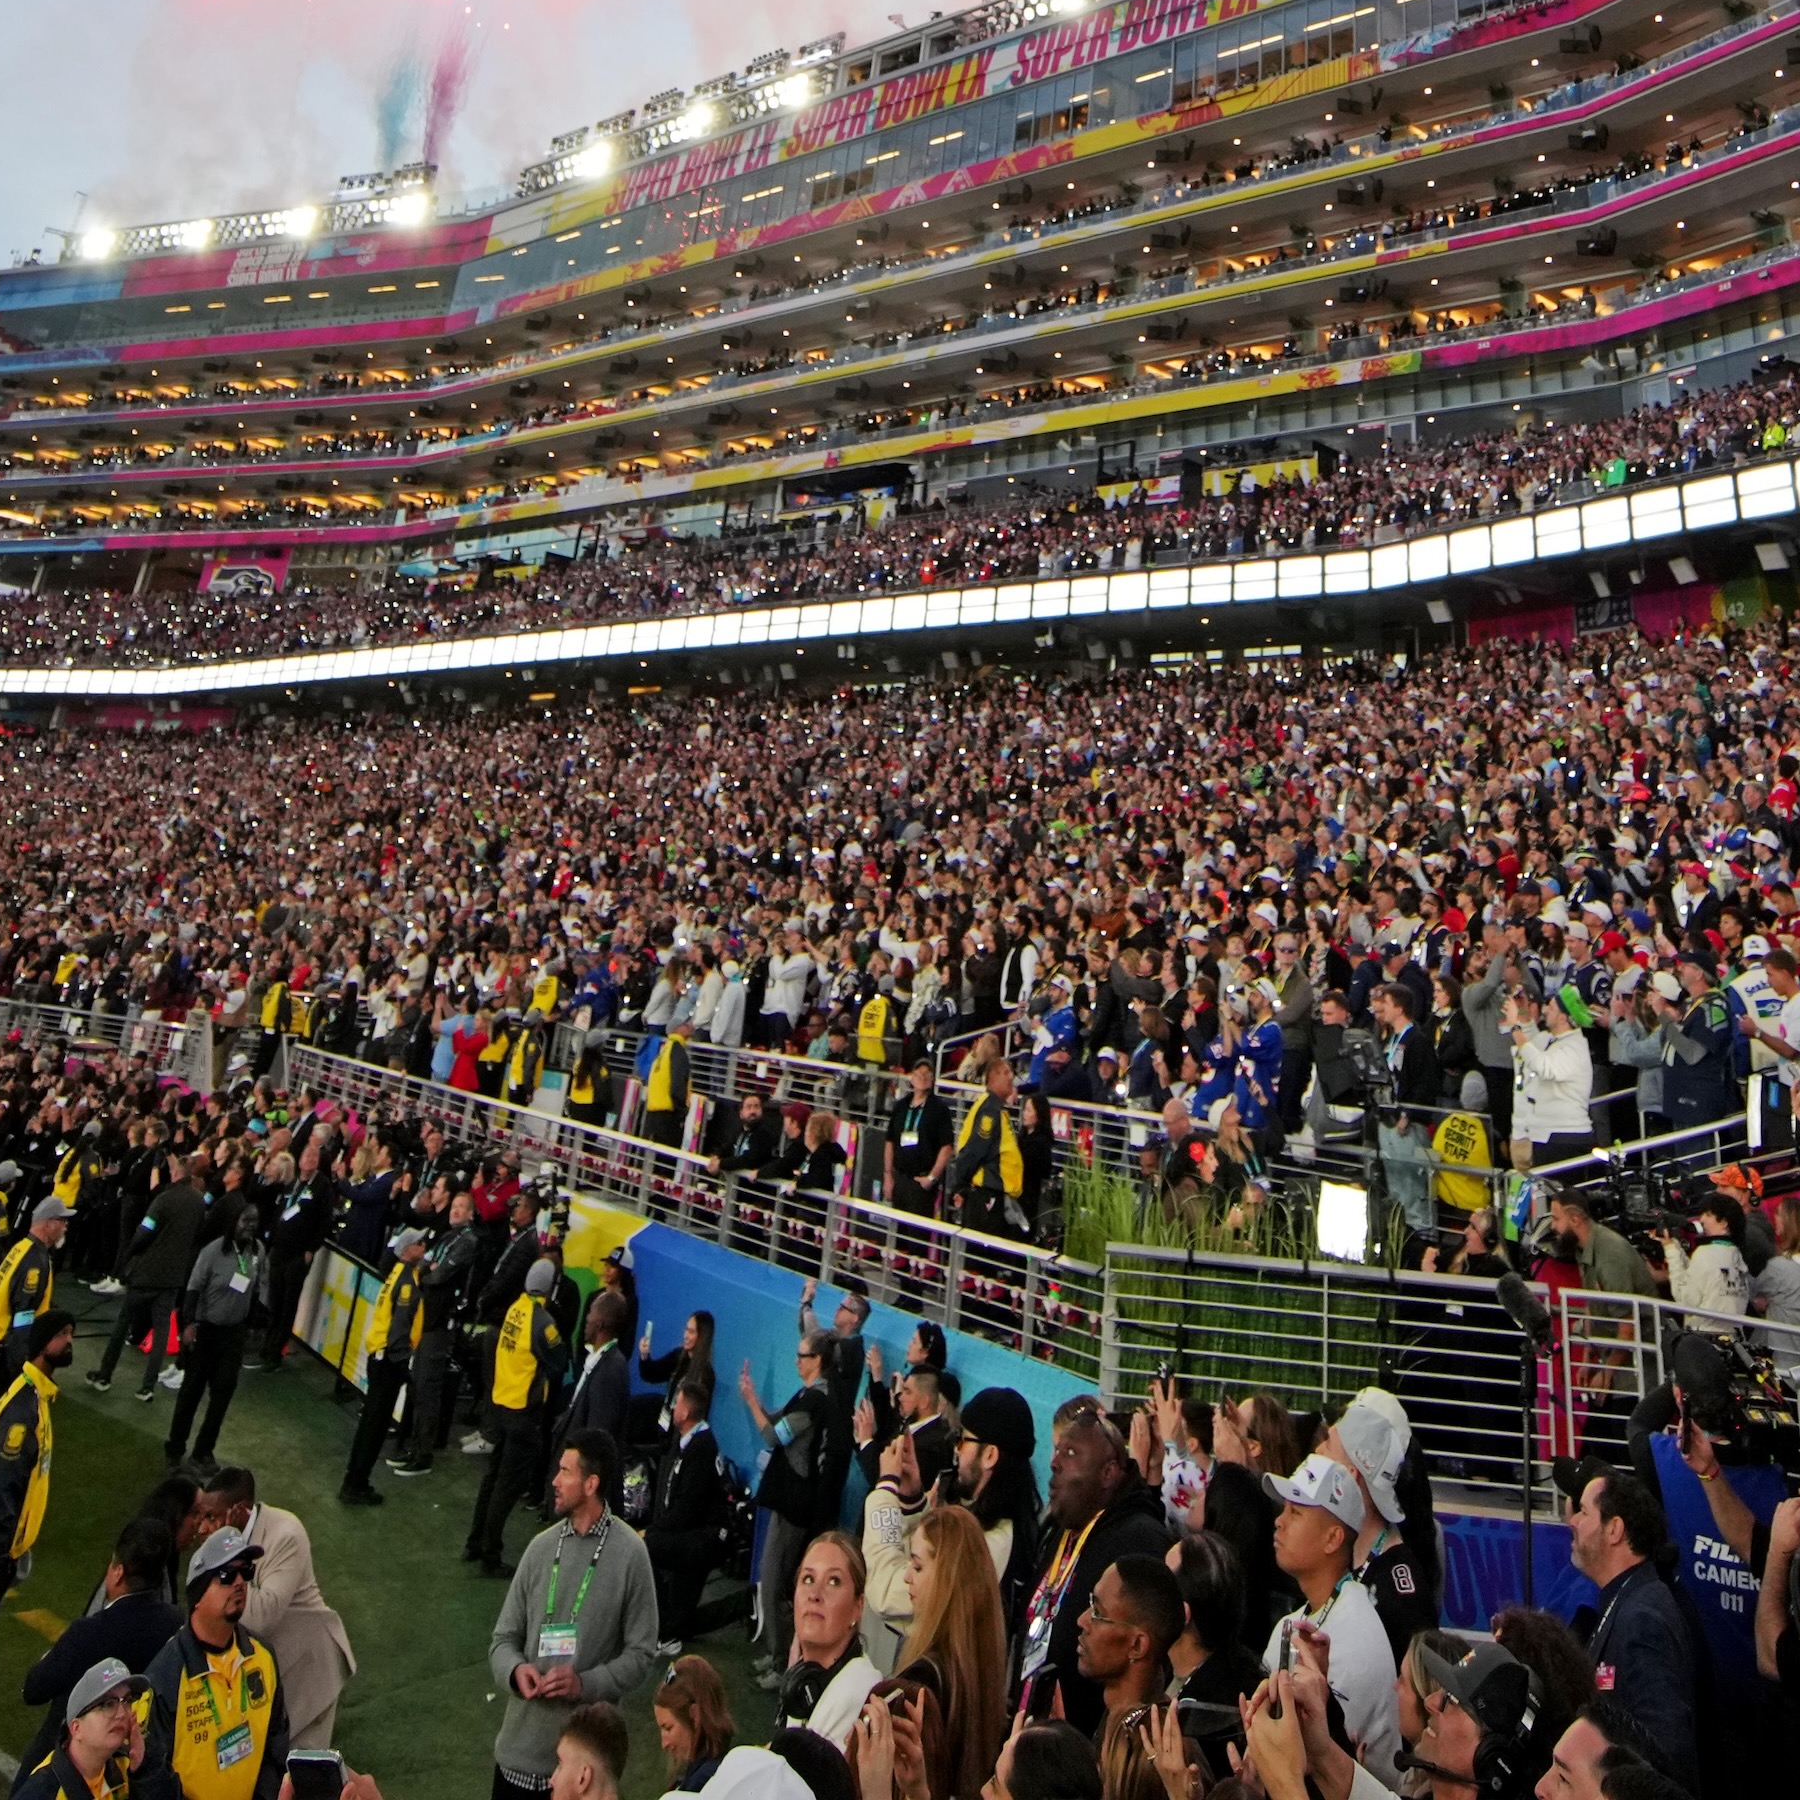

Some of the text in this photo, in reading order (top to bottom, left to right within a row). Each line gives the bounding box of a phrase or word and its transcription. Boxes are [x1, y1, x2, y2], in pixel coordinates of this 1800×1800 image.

[1010, 7, 1115, 86] SUPER
[784, 48, 996, 157] SUPER BOWL LX
[604, 118, 782, 216] SUPER BOWL LX
[1449, 1116, 1477, 1137] CSC
[1443, 1141, 1470, 1162] STAFF
[1693, 1534, 1741, 1563] FIL
[1391, 1563, 1417, 1594] 8
[1693, 1561, 1762, 1592] CAMER
[1719, 1591, 1745, 1614] 011
[186, 1713, 214, 1733] STAFF
[193, 1731, 210, 1745] 99
